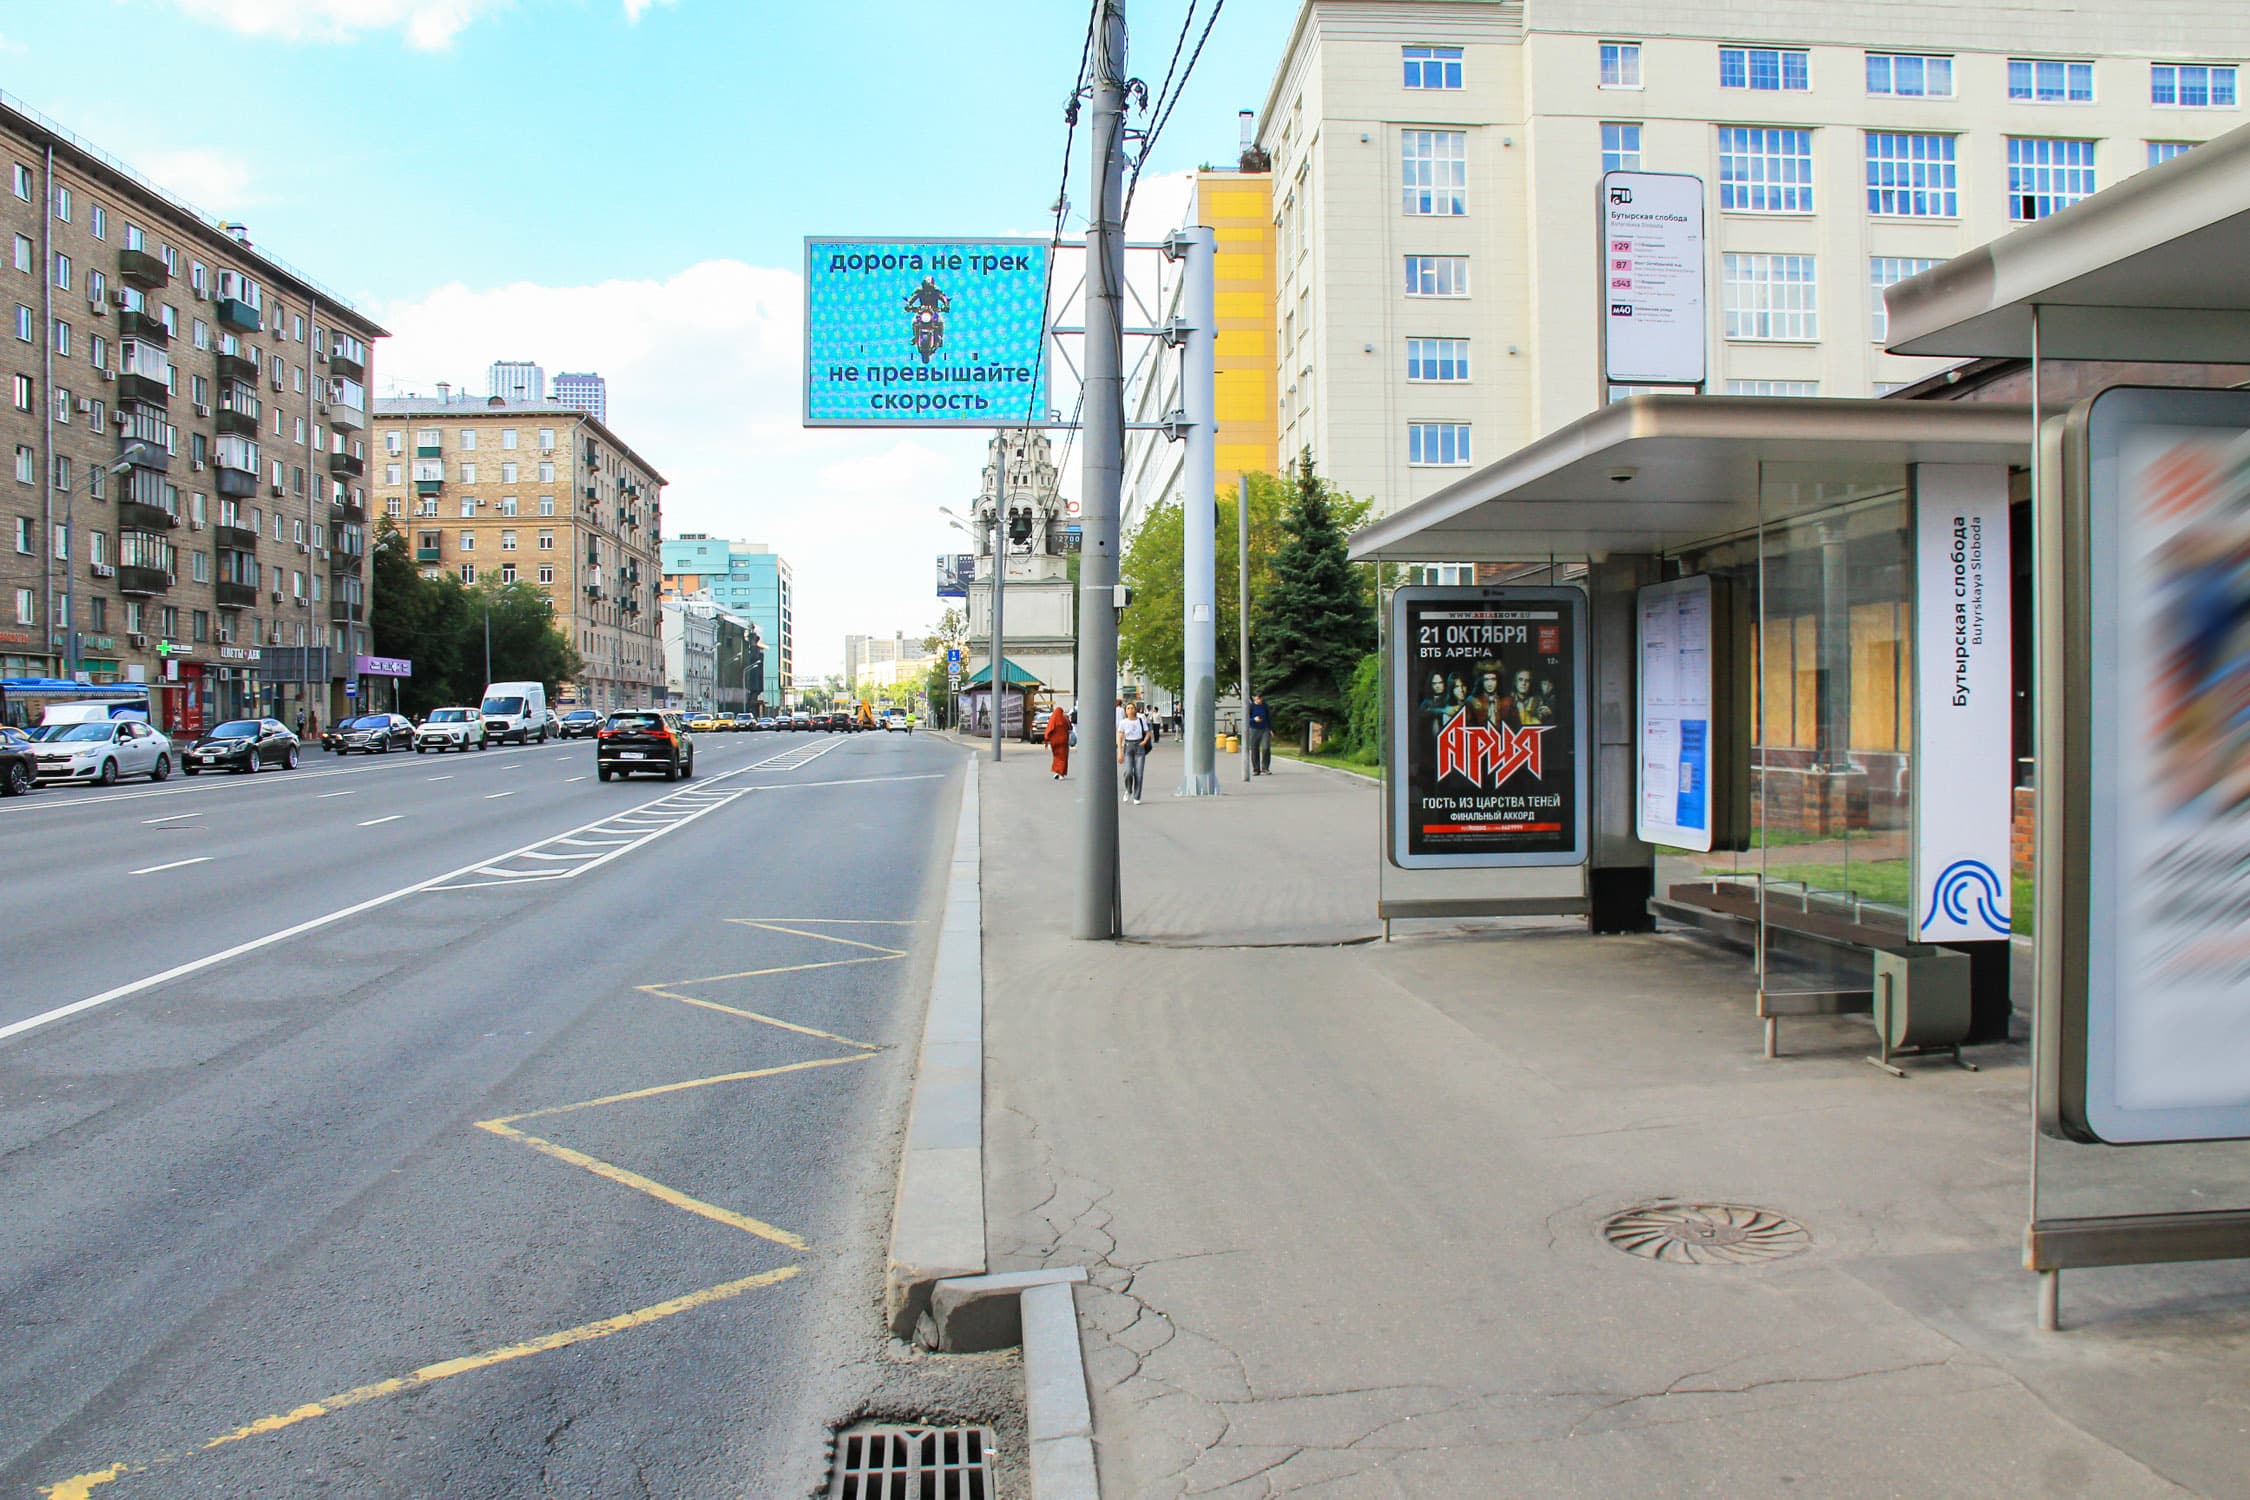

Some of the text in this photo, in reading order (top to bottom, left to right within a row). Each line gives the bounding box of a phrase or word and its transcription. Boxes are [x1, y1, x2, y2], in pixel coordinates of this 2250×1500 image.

[1611, 211, 1688, 222] Бутырская слобода
[829, 254, 1030, 275] дорога не трек
[1615, 261, 1627, 269] 87
[829, 362, 1030, 387] не превышайте
[870, 394, 989, 413] скорость
[1970, 516, 1985, 645] Butyrskaya Sloboda
[1951, 516, 1970, 707] Бутырская слобода
[1420, 626, 1440, 644] 21
[1446, 625, 1528, 644] ОКТЯБРЯ
[220, 647, 244, 659] ЦВЕТЫ
[1420, 647, 1493, 658] ВТБ АРЕНА
[1436, 705, 1557, 789] АРИЯ
[1422, 793, 1561, 810] ГОСТЬ ИЗ ЦАРСТВА ТЕНЕЙ
[1450, 810, 1535, 822] ФИНАЛЬНЫЙ АККОРД
